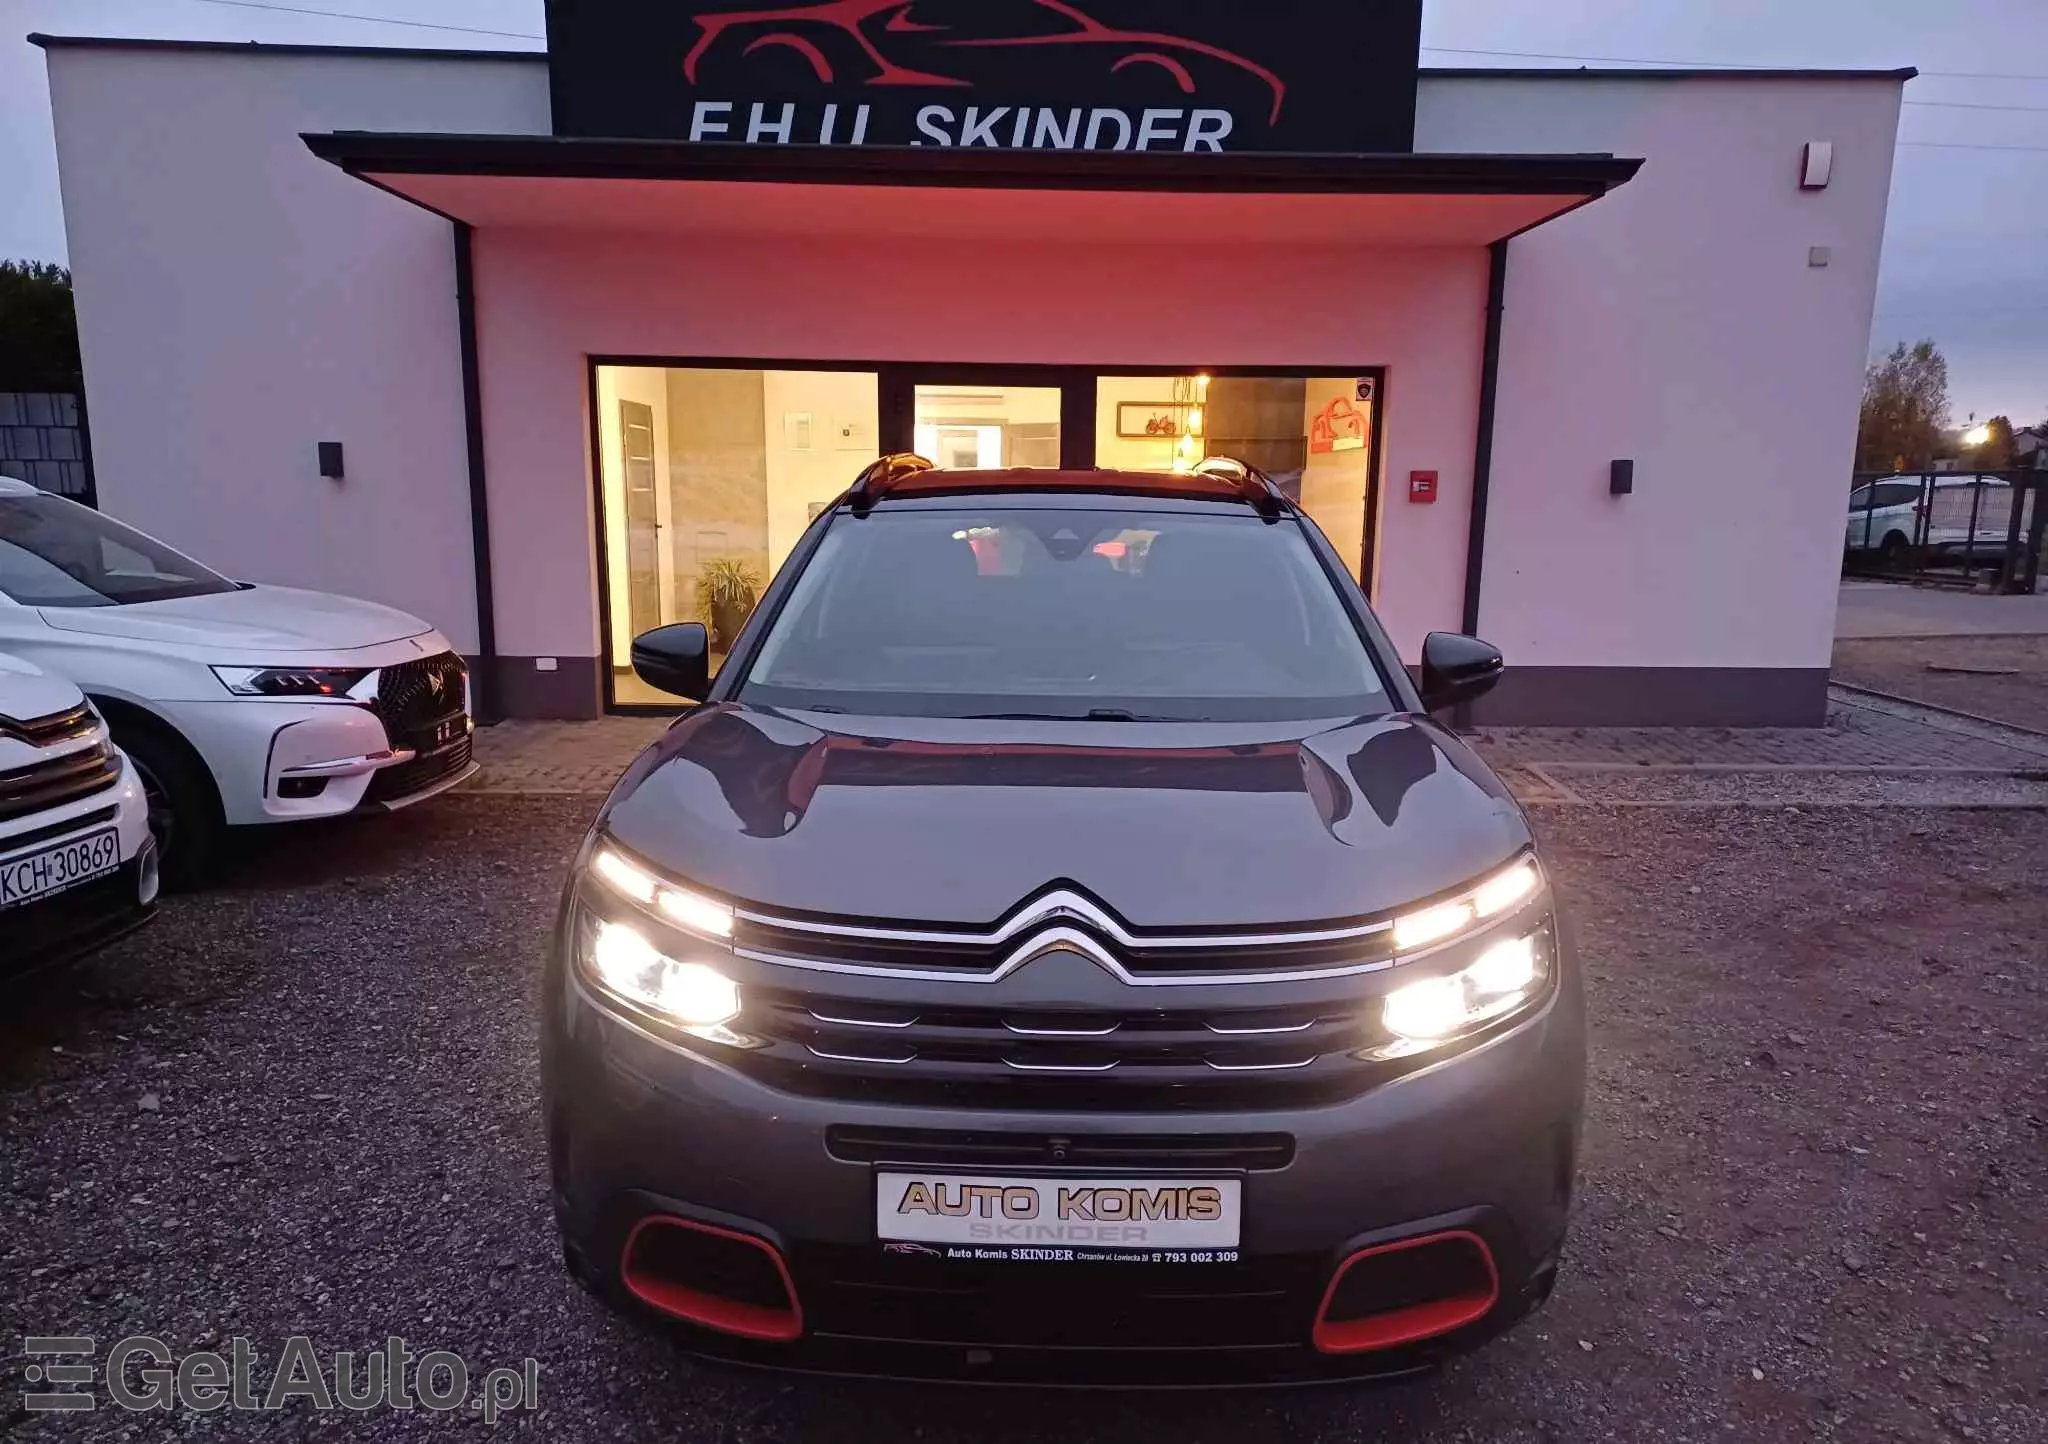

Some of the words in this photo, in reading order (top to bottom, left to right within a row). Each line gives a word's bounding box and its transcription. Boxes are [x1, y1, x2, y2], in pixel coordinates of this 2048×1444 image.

[910, 105, 1233, 153] SKINDER
[0, 856, 48, 901] KCH
[54, 835, 114, 882] 30869
[897, 1181, 1040, 1220] AUTO
[1058, 1187, 1222, 1222] KOMIS
[969, 1223, 1148, 1242] SKINDER
[947, 1248, 972, 1258] Auto
[974, 1248, 1008, 1259] Komis
[1011, 1248, 1073, 1260] SKINDER
[1165, 1252, 1187, 1262] 793
[1191, 1252, 1213, 1262] 002
[1216, 1252, 1238, 1262] 309
